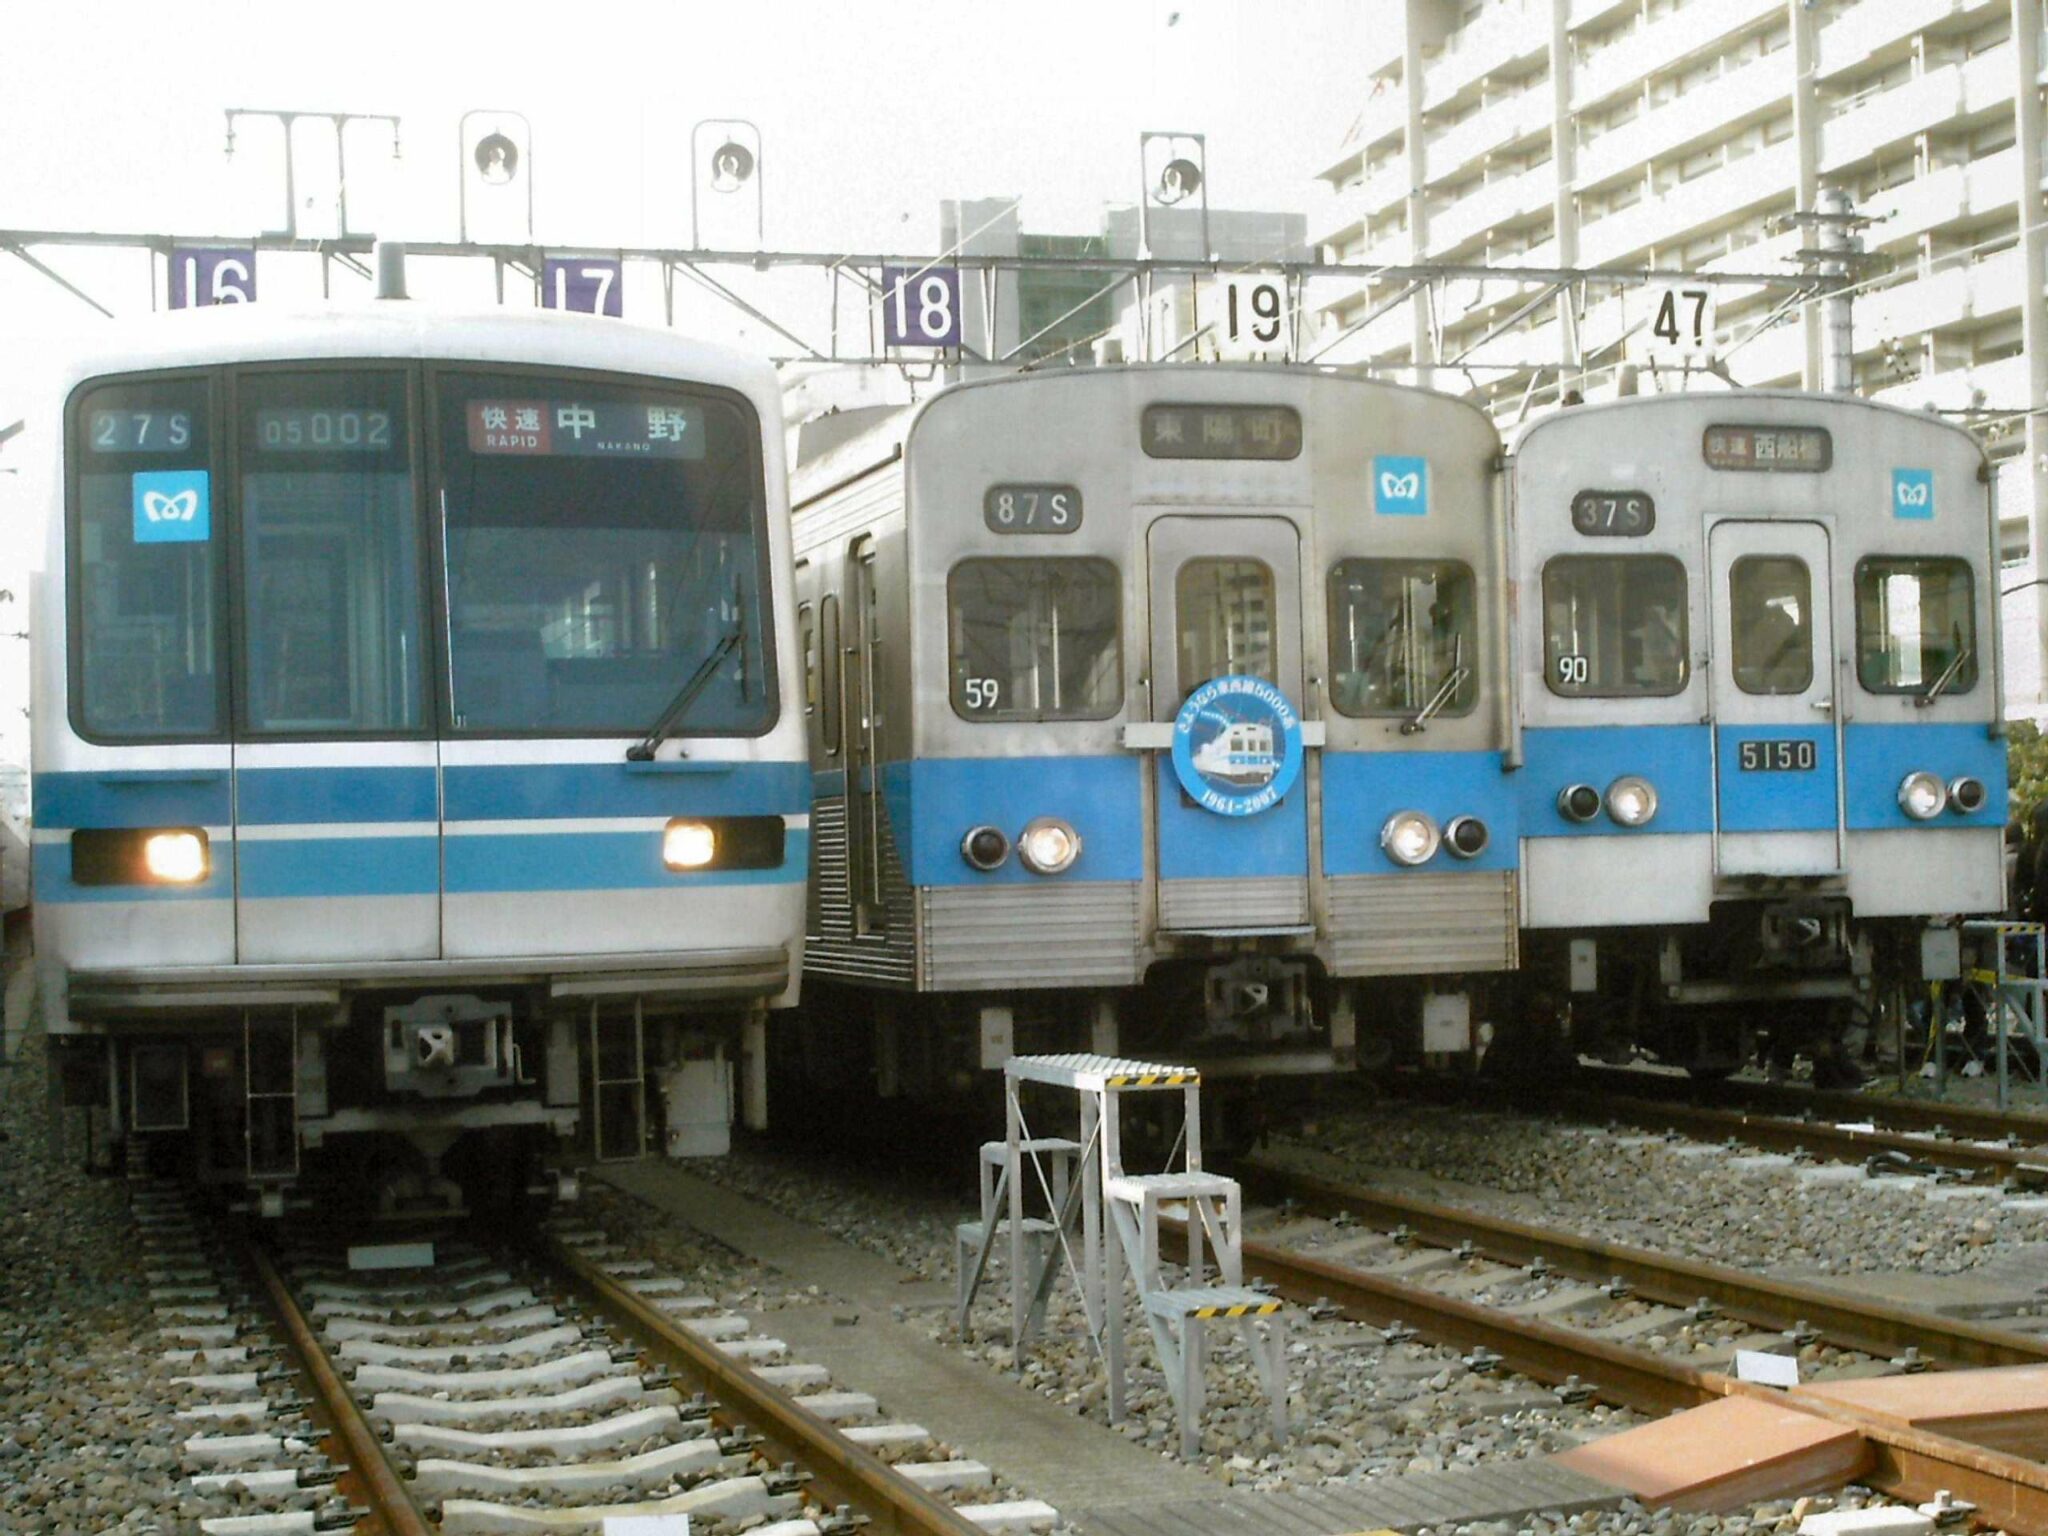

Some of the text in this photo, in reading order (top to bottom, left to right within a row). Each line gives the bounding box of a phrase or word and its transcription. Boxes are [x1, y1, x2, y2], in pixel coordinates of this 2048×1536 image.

[185, 257, 249, 308] 16
[555, 267, 615, 315] 17
[895, 275, 952, 339] 18
[1228, 283, 1280, 343] 19
[1654, 290, 1708, 347] 47
[97, 413, 188, 446] 27S
[480, 405, 541, 432] 快速
[486, 434, 651, 452] RAPID NAKANO
[998, 493, 1068, 525] 87S
[1583, 499, 1641, 528] 37S
[1559, 656, 1588, 683] 90
[965, 678, 999, 709] 59
[1742, 742, 1812, 769] 5150
